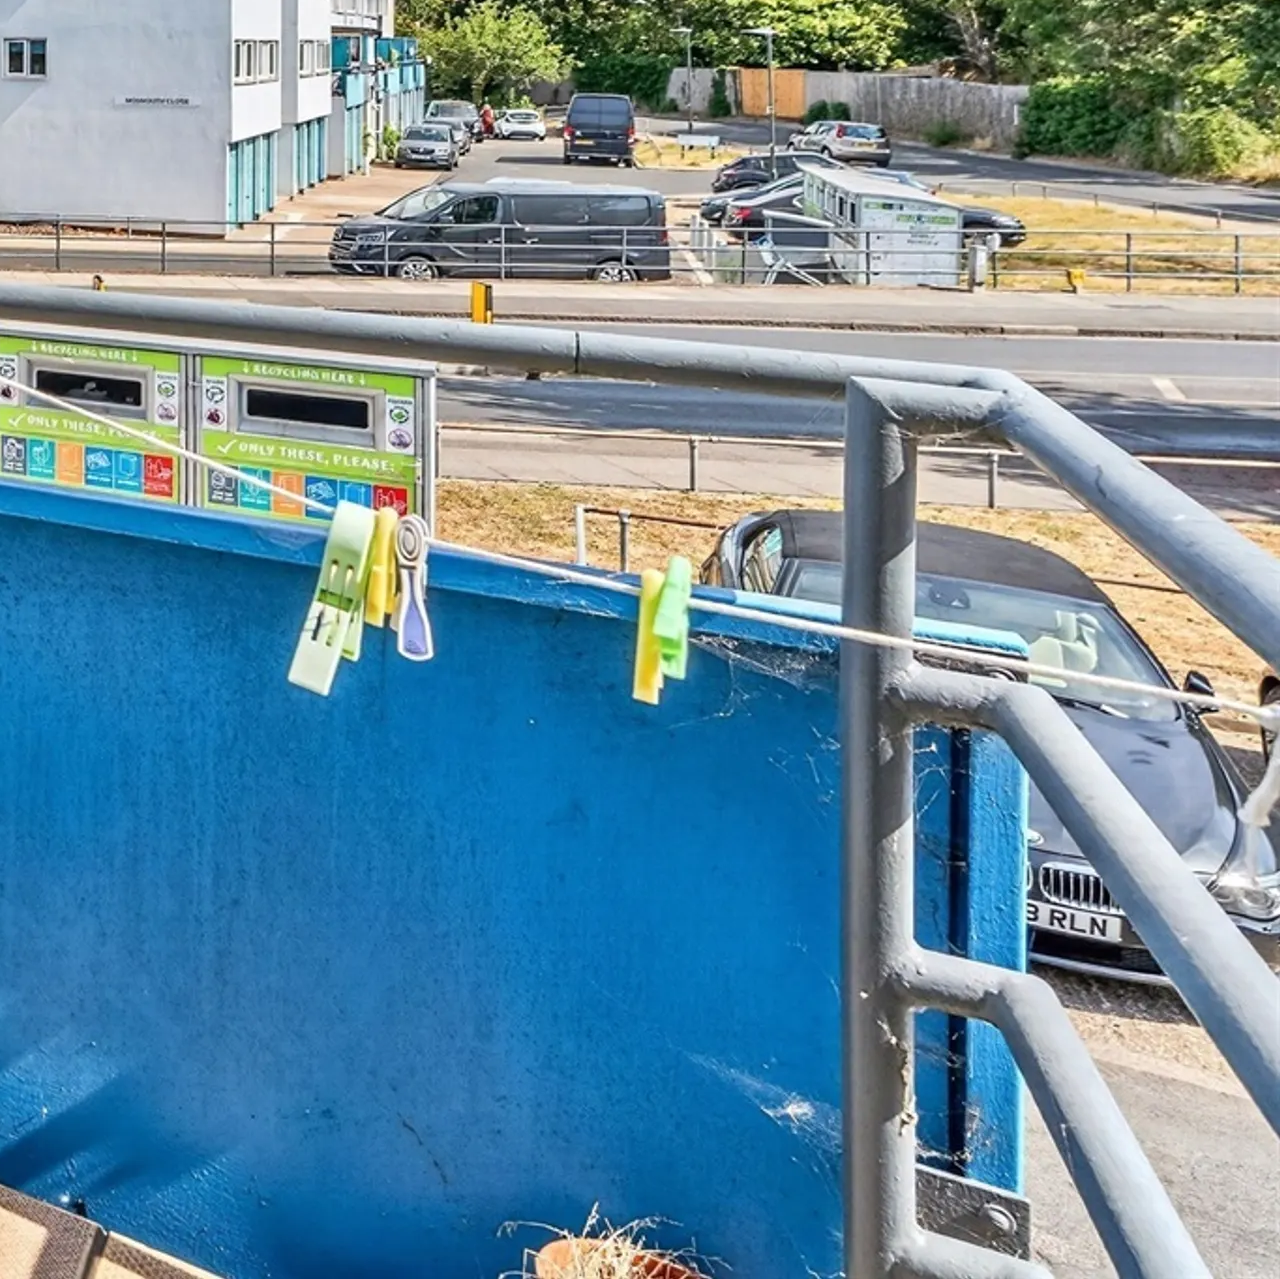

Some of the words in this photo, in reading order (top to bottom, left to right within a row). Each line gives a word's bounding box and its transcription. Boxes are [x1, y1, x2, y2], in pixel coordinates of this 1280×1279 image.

[40, 342, 98, 359] RECYCLING
[100, 348, 128, 362] HERE
[253, 363, 320, 381] RECYCLING
[322, 370, 354, 385] HERE
[27, 414, 60, 429] ONLY
[239, 441, 275, 457] ONLY
[279, 446, 330, 466] THESE,
[1049, 909, 1107, 937] RLN
